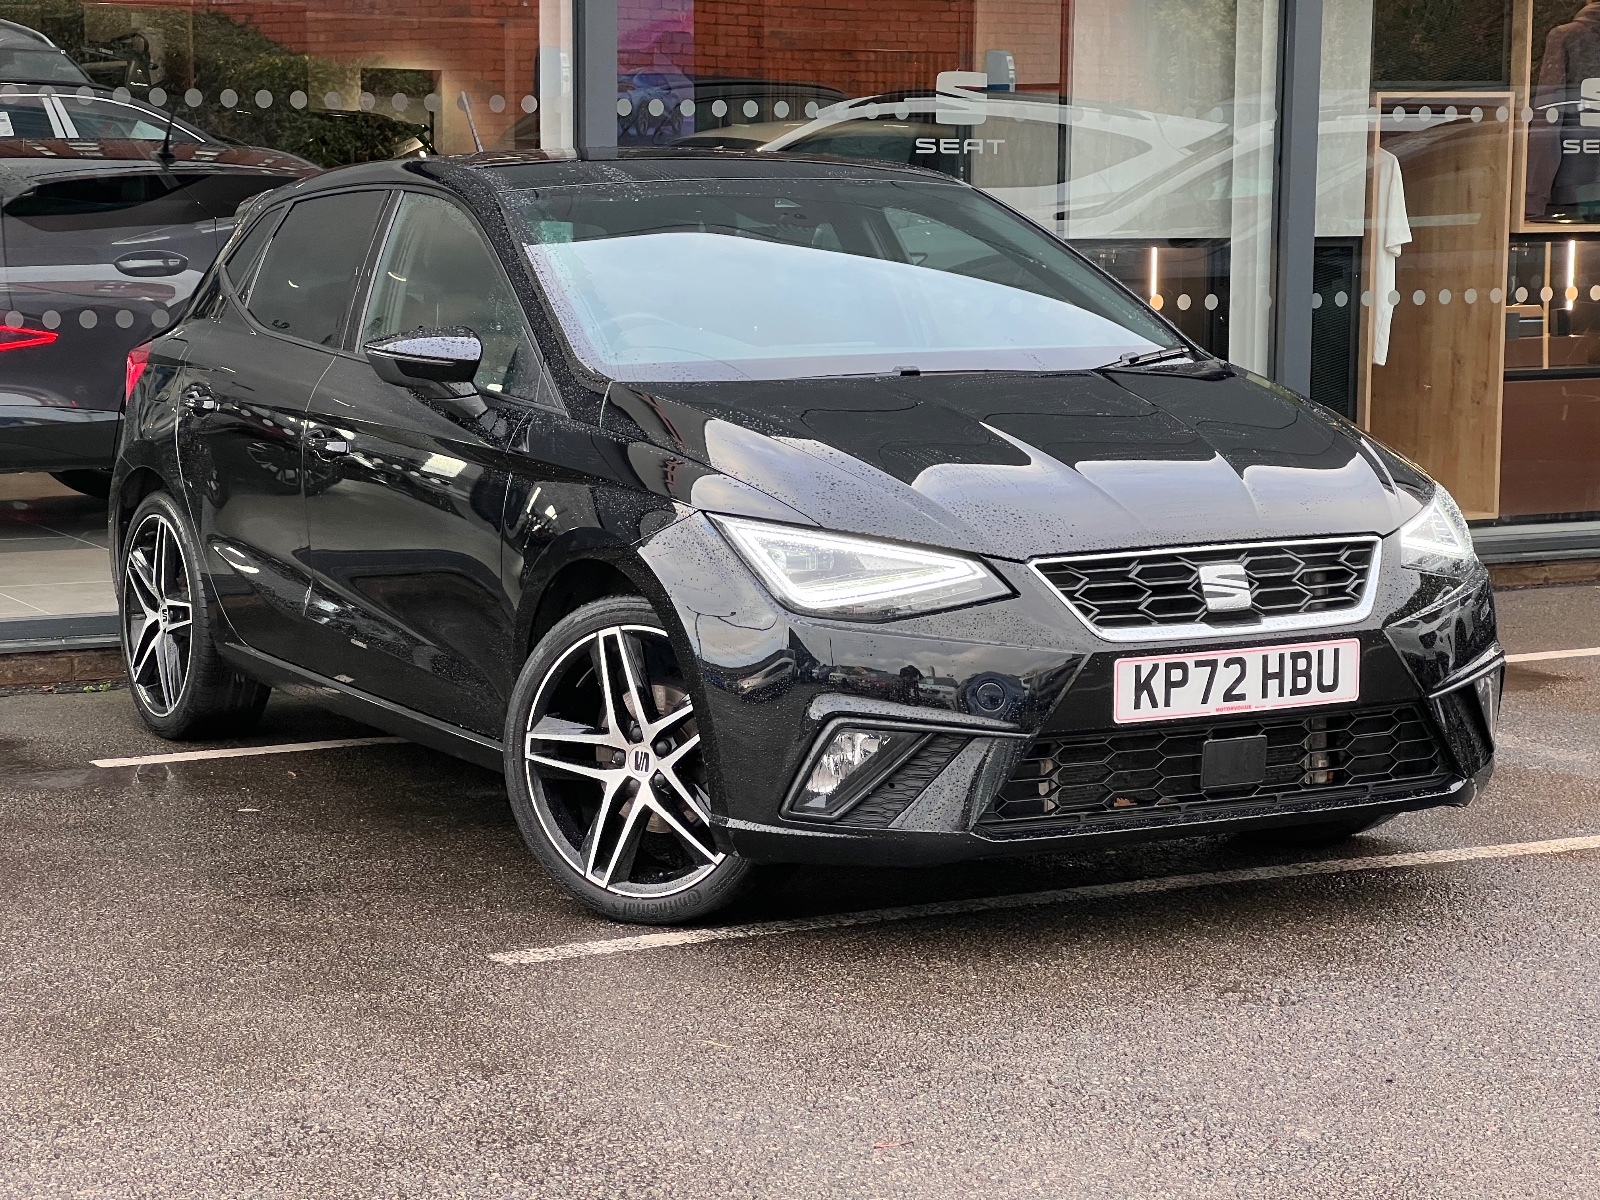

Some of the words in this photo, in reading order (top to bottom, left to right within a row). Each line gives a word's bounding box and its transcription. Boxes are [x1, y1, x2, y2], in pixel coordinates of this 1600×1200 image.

[915, 138, 1005, 154] SEAT
[1563, 140, 1600, 154] SE
[1133, 656, 1247, 710] KP72
[1261, 648, 1340, 699] HBU
[1215, 704, 1252, 713] MOTORVOGUE
